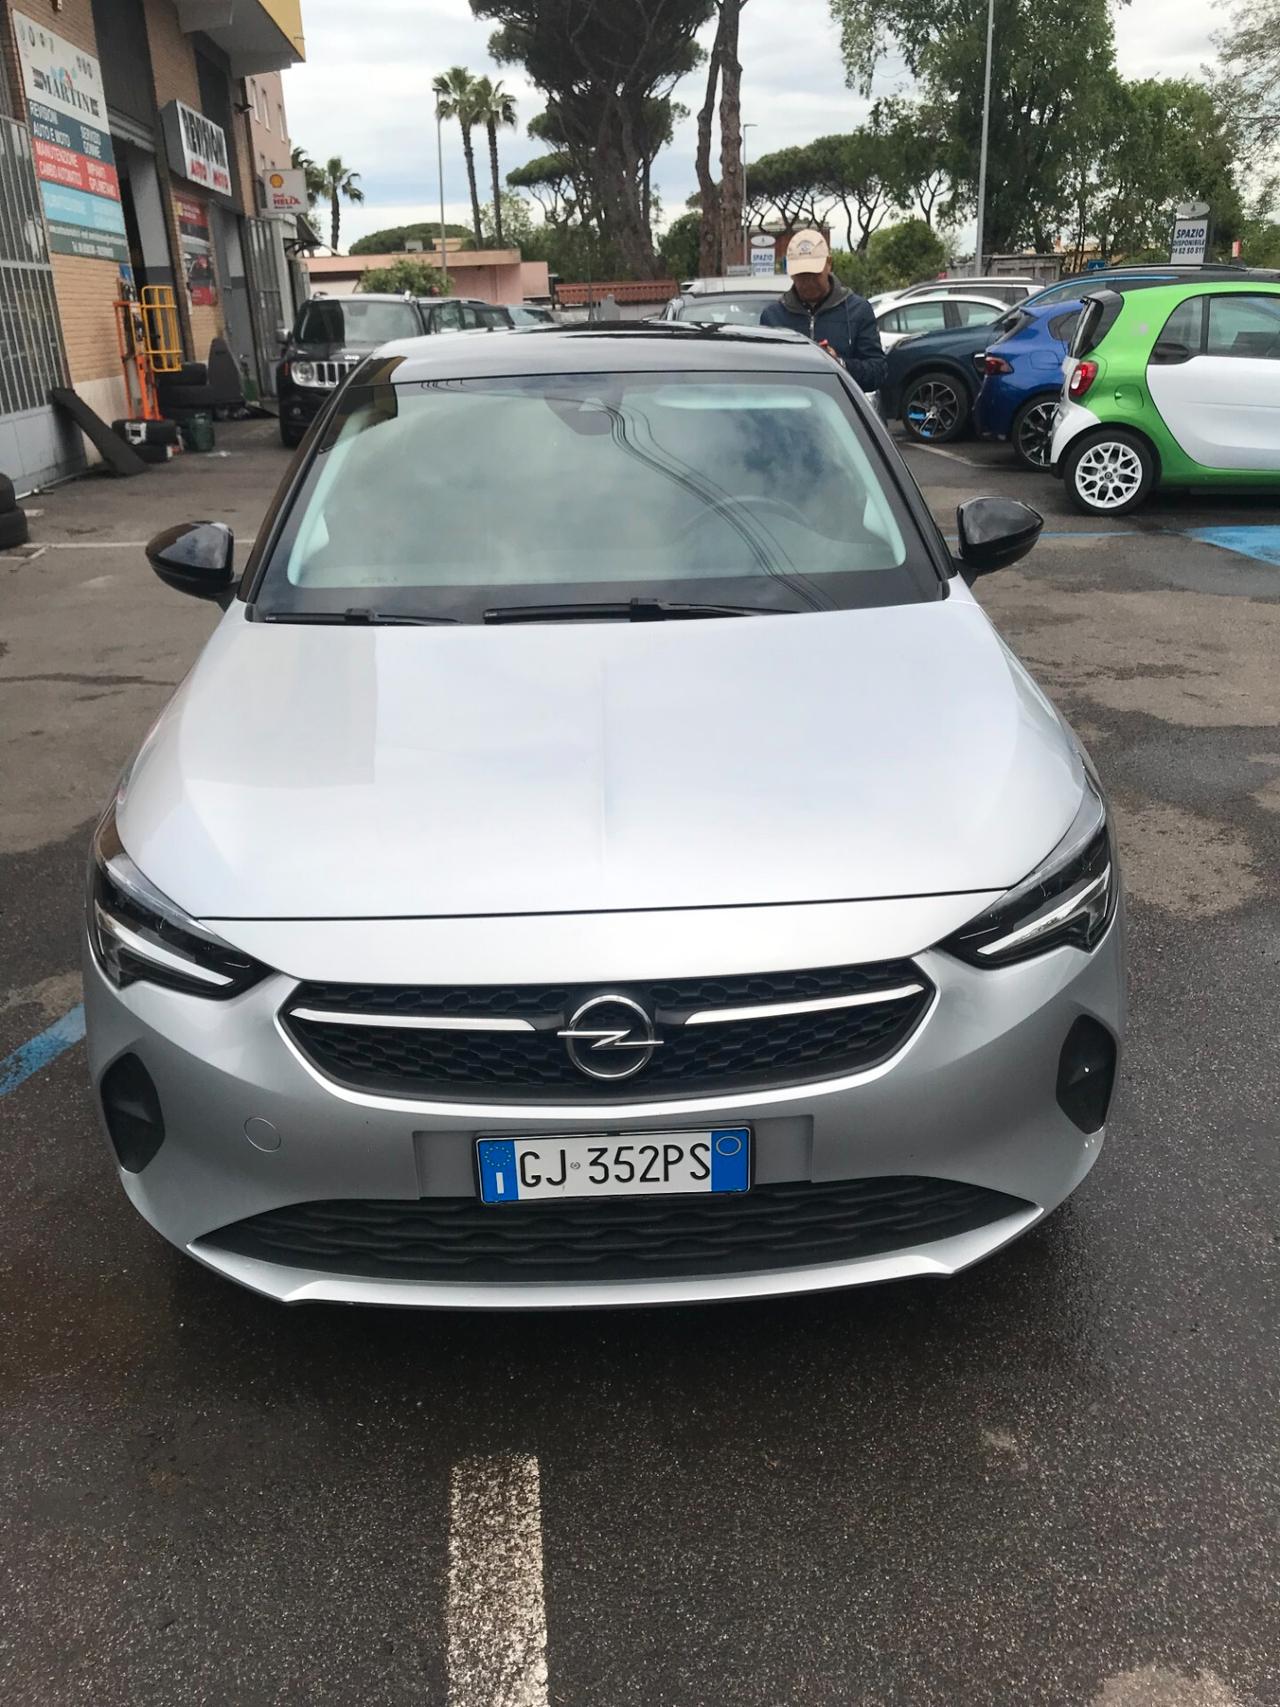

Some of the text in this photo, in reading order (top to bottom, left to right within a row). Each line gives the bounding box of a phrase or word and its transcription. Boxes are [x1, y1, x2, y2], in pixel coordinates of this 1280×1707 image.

[33, 121, 50, 140] AUTO
[190, 159, 208, 181] AUTO
[1176, 228, 1205, 238] SPAZIO
[519, 1142, 712, 1188] GJ 352PS
